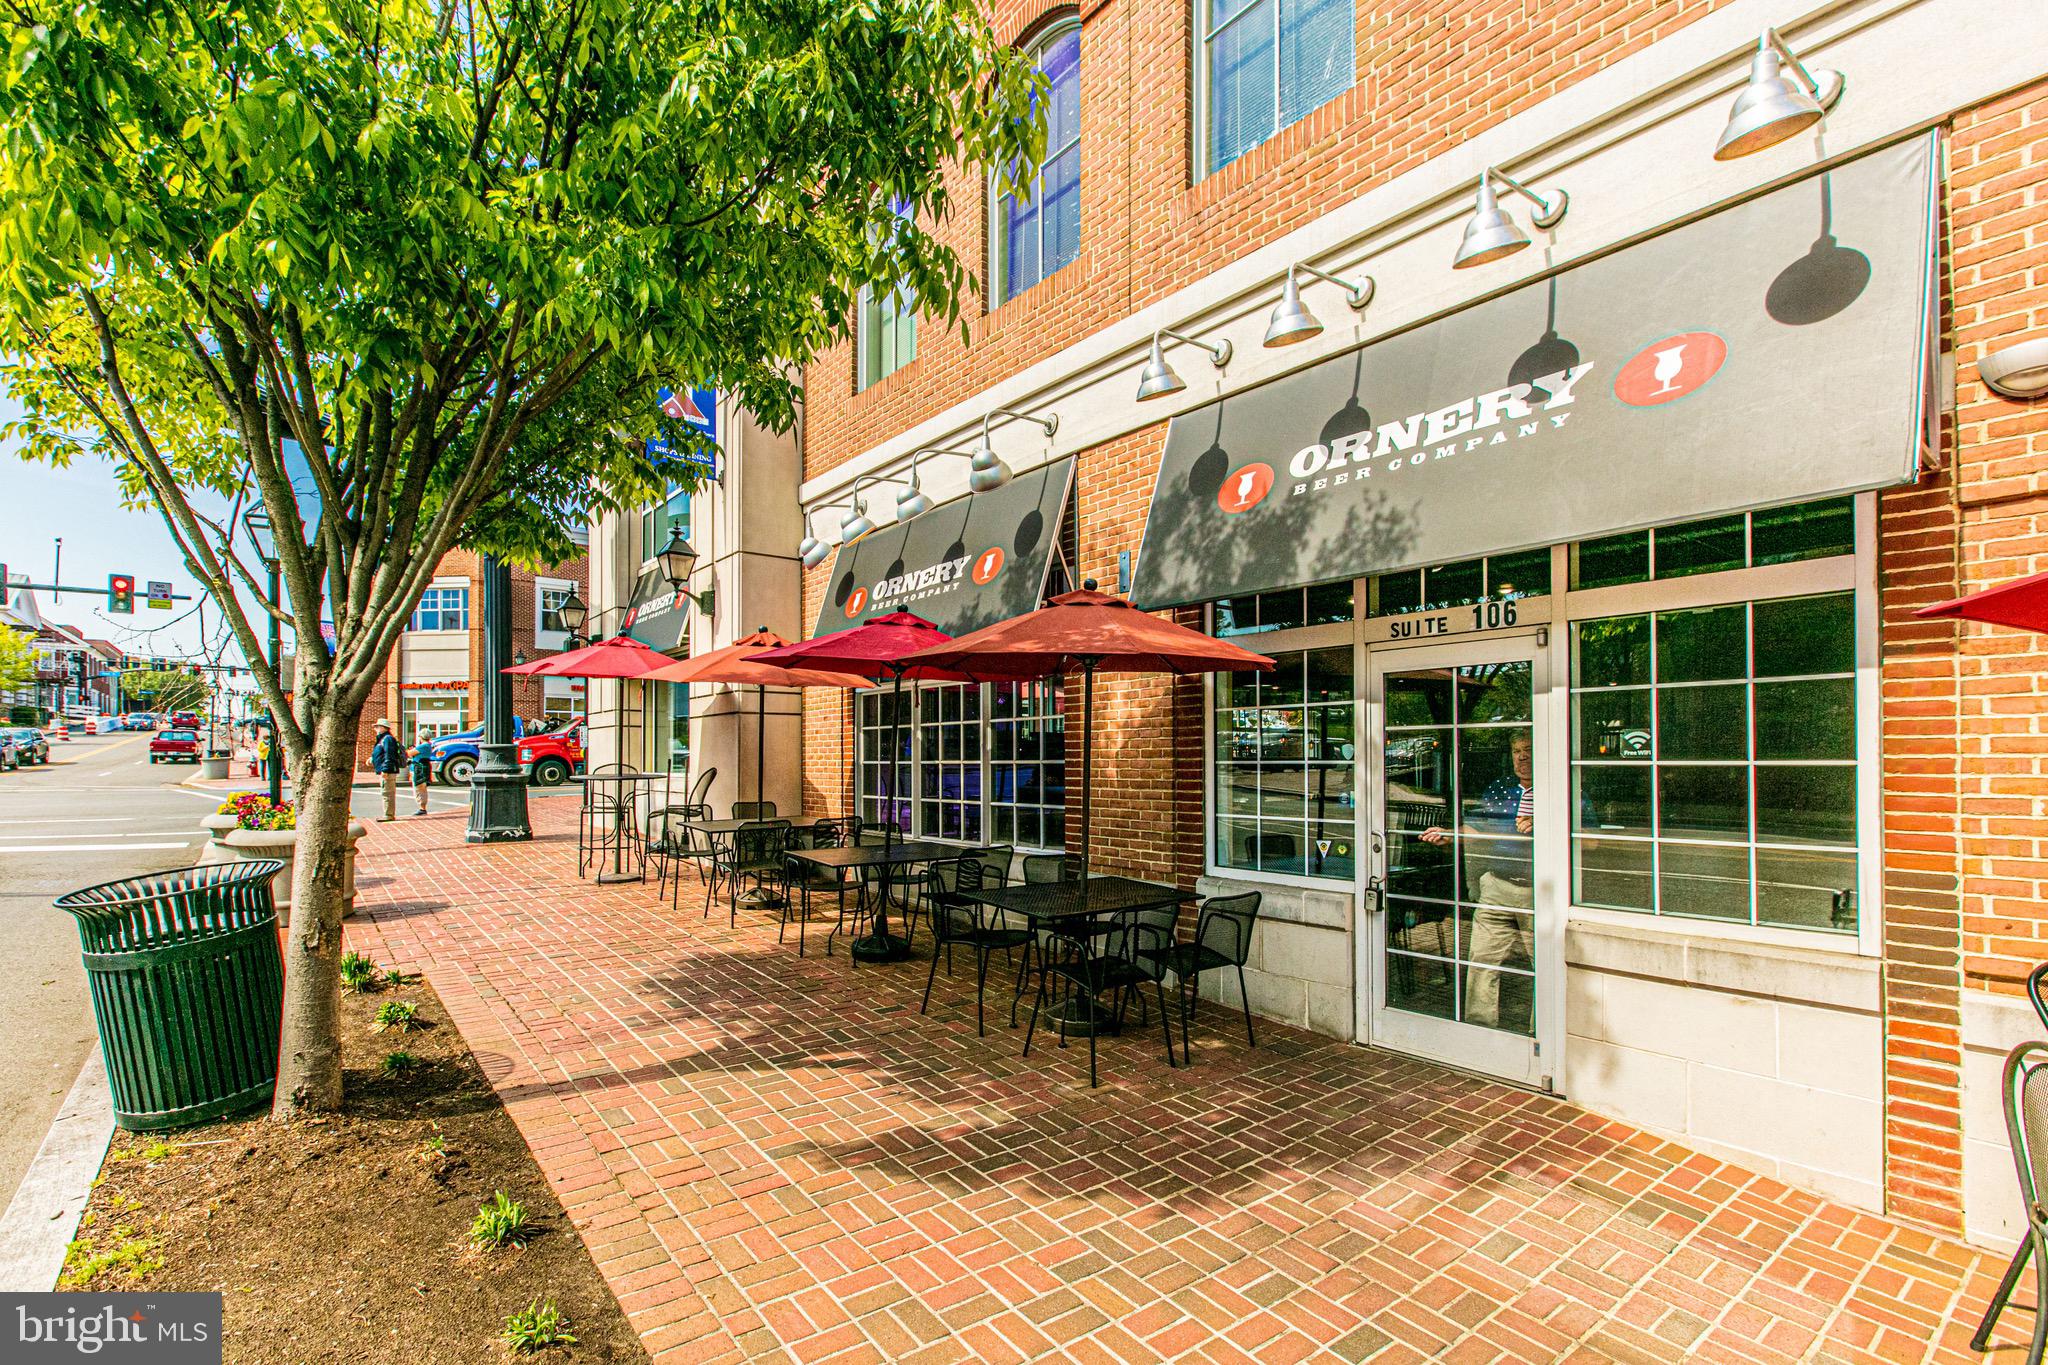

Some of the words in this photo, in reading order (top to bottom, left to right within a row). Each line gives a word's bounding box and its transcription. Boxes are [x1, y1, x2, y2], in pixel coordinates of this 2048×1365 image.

[1288, 361, 1594, 478] ORNERY
[1292, 466, 1372, 496] BEER
[1388, 412, 1571, 471] COMPANY
[870, 598, 899, 611] BEER
[902, 582, 961, 603] COMPANY
[872, 554, 972, 601] ORNERY
[637, 591, 676, 617] ORNERY
[1390, 616, 1448, 638] SUITE
[1472, 600, 1517, 629] 106
